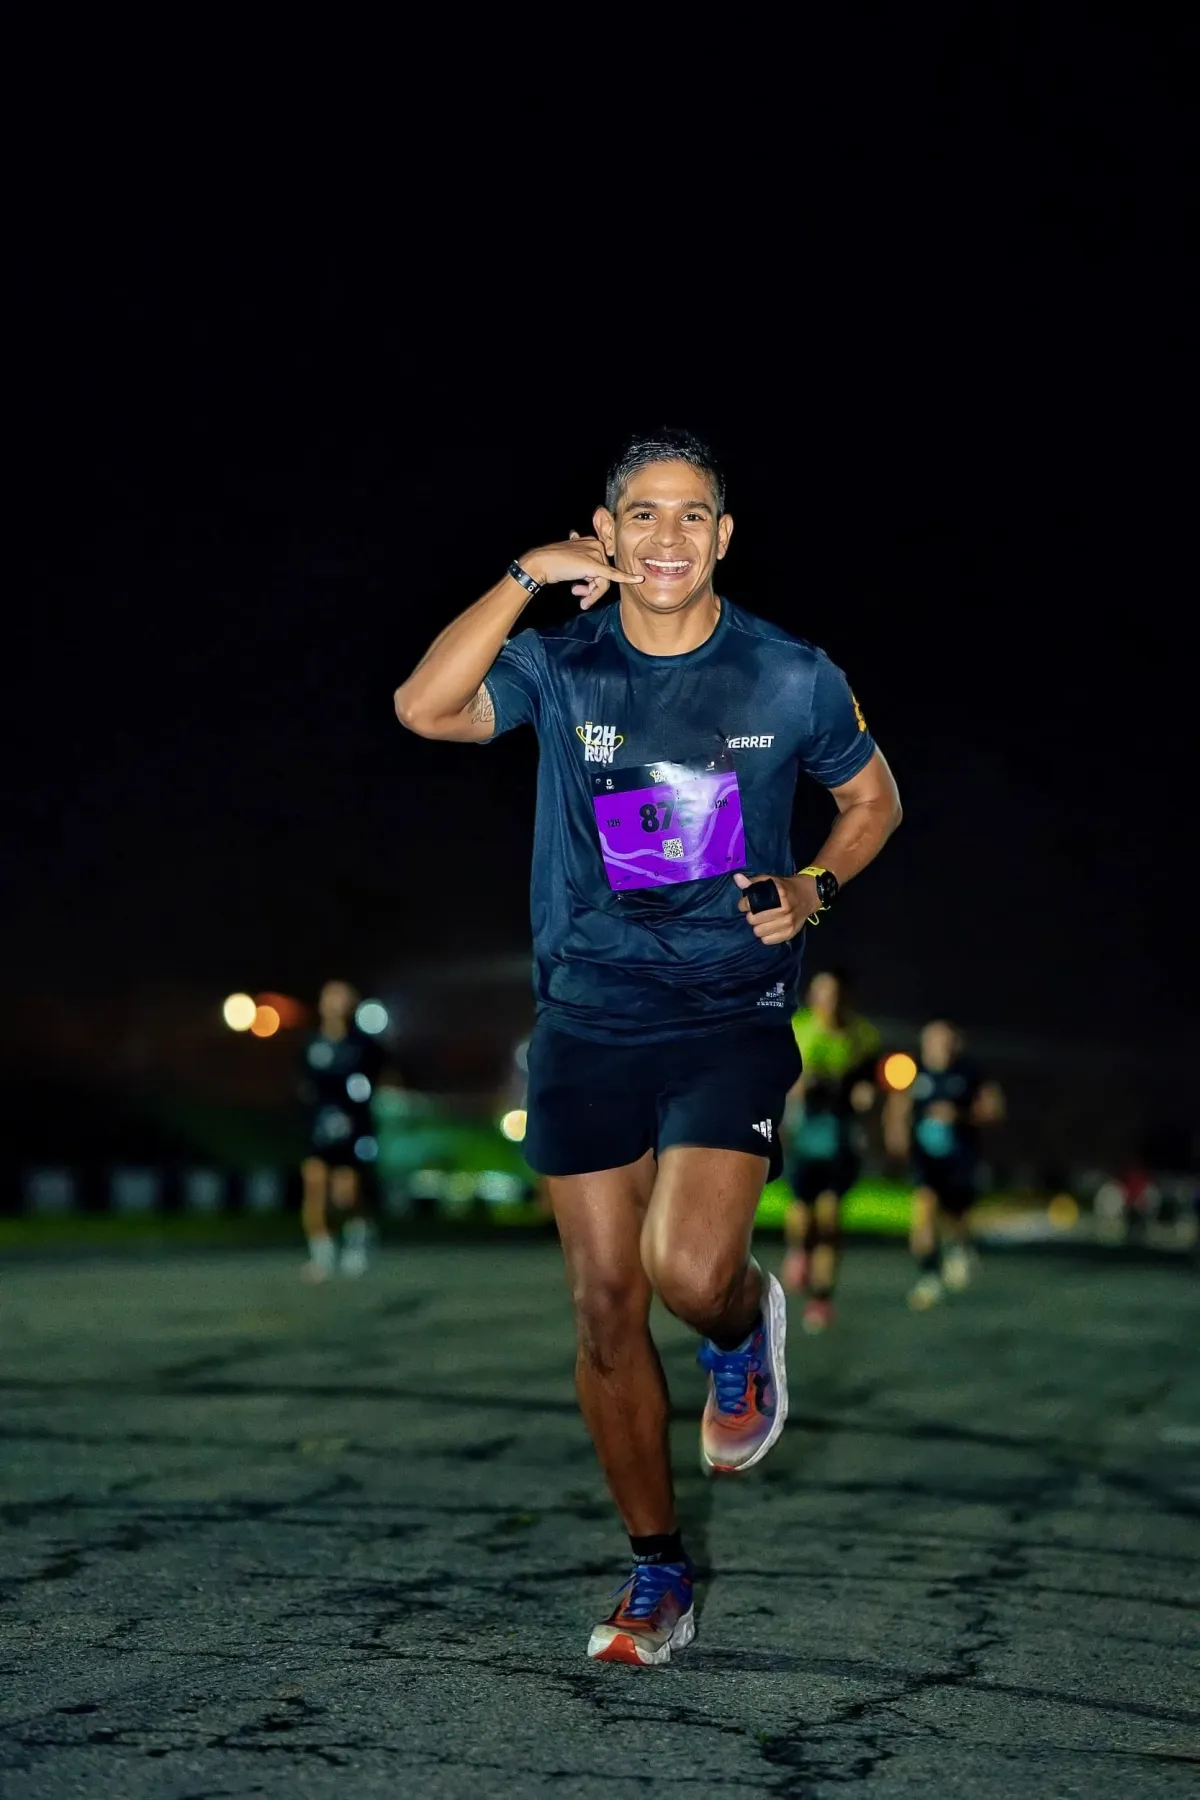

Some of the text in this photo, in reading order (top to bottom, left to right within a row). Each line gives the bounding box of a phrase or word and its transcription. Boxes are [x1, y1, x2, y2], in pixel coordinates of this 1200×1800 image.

[585, 722, 616, 746] 12H
[585, 745, 614, 764] RUN
[715, 799, 728, 809] 12H
[606, 819, 621, 828] 12H
